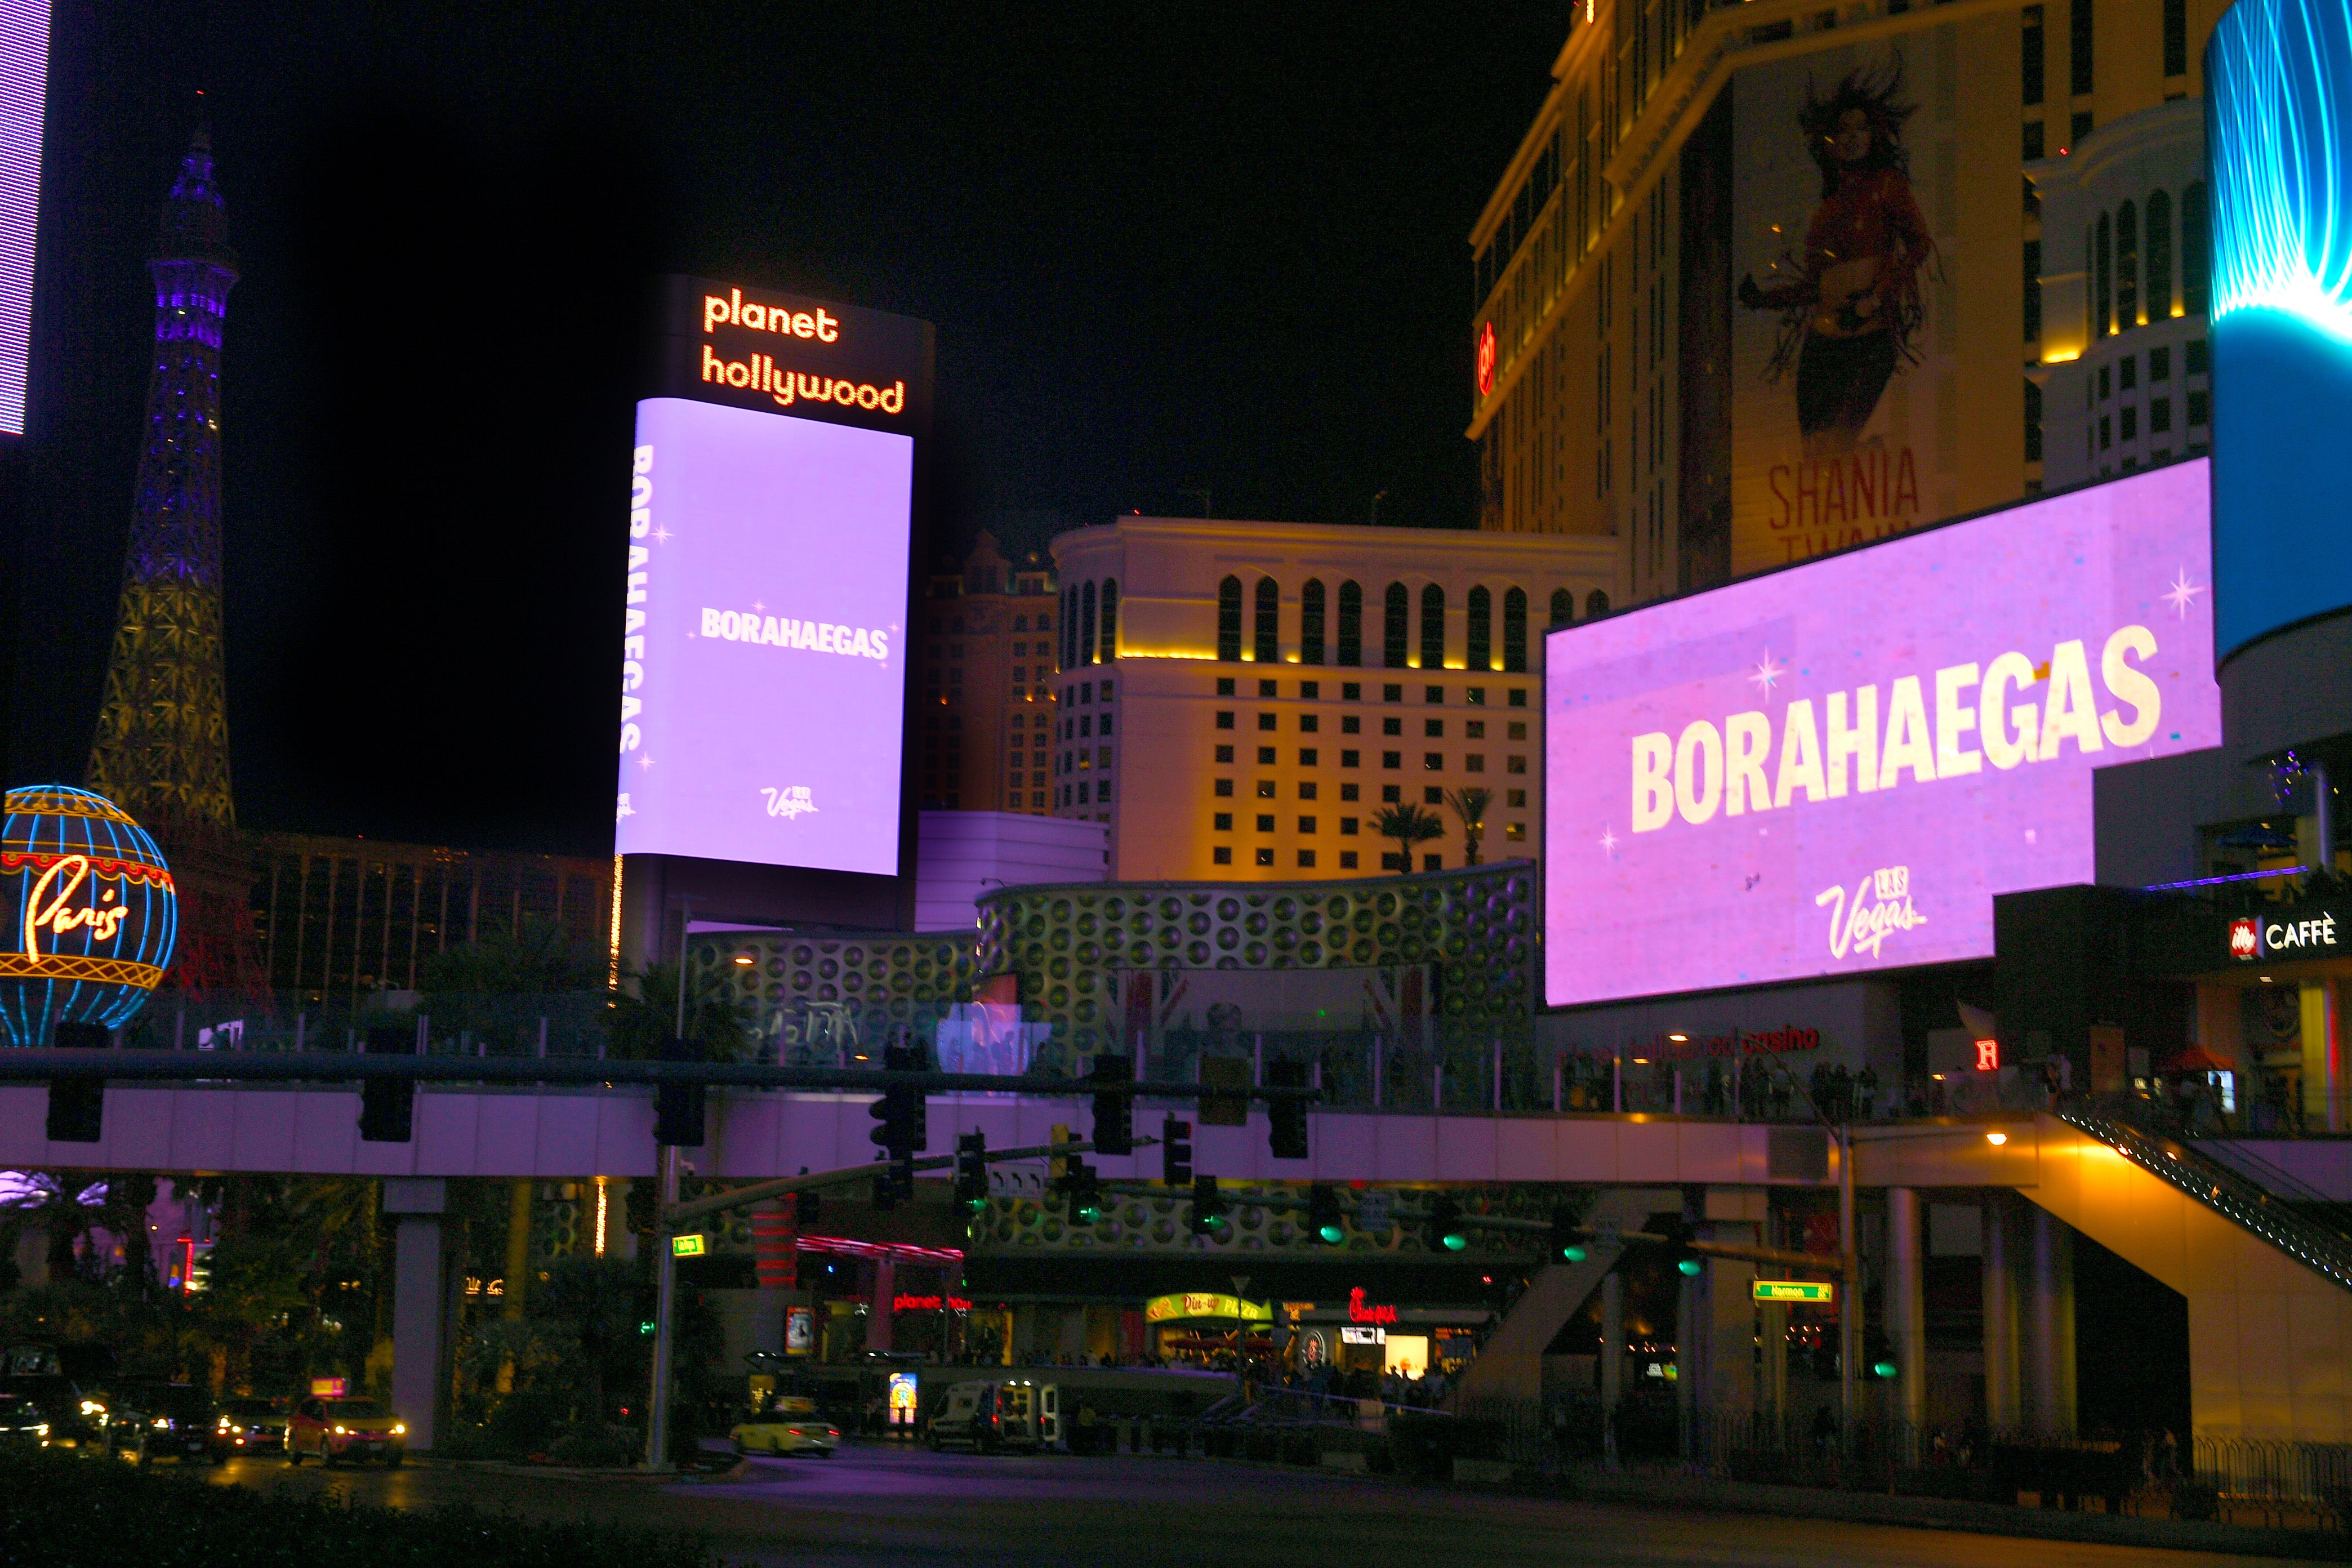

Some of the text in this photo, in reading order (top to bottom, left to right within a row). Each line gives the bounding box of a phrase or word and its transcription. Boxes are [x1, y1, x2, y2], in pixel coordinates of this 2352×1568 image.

[704, 287, 839, 344] planet
[702, 344, 905, 415] hollywood
[1769, 446, 1919, 530] SHANIA
[701, 607, 889, 660] BORAHAEGAS
[1632, 624, 2162, 834] BORAHAEGAS
[25, 854, 128, 964] Paris
[1876, 868, 1908, 897] LAS
[1815, 876, 1927, 960] Vegas
[2231, 911, 2337, 953] illy CAFFÈ
[1741, 1023, 1819, 1055] casino
[893, 1293, 944, 1312] planet
[1771, 1285, 1805, 1298] Harmon
